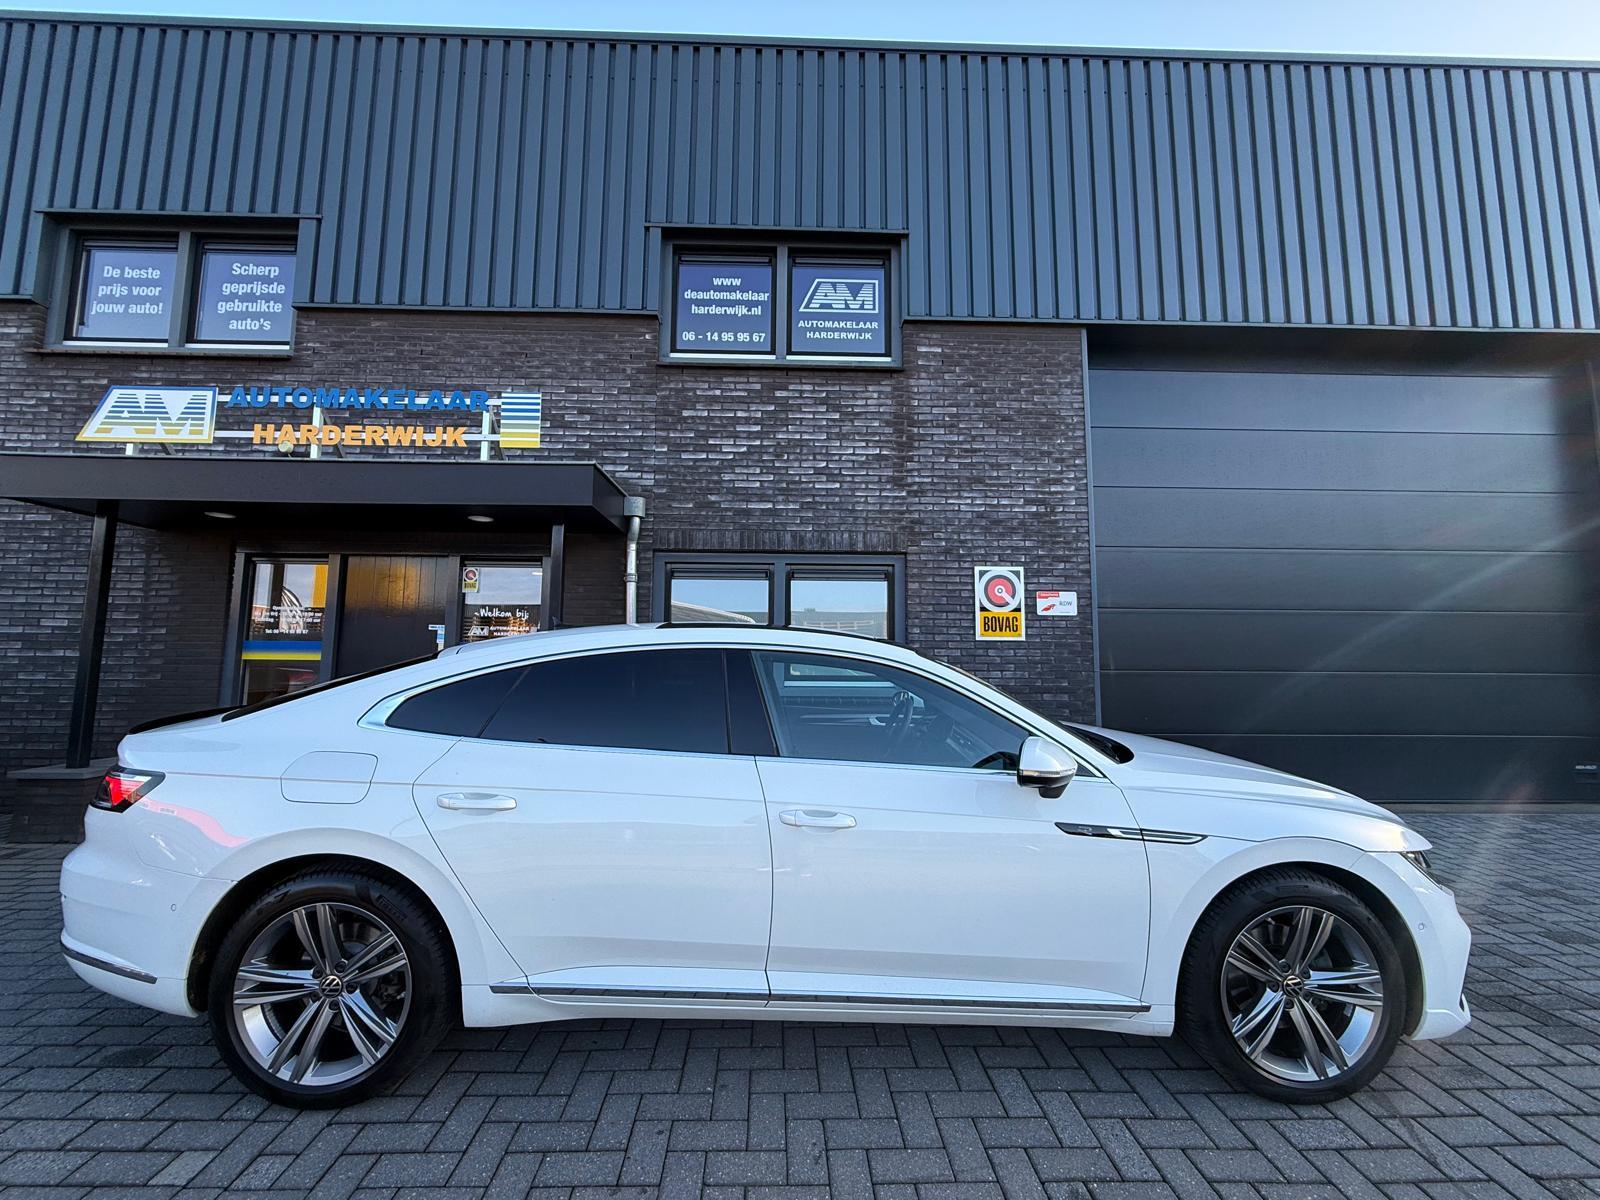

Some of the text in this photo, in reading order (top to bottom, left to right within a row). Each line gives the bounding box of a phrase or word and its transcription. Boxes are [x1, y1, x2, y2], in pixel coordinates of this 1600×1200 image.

[103, 266, 161, 279] De beste
[231, 263, 279, 278] Scherp
[222, 281, 286, 296] geprijsde
[712, 277, 741, 287] www
[98, 283, 162, 297] prijs voor
[684, 289, 769, 302] deautomakelaar
[91, 301, 163, 315] jouw auto!
[217, 299, 283, 314] gebruikte
[691, 304, 762, 317] harderwijk.nl
[229, 318, 271, 331] auto's
[798, 320, 879, 329] AUTOMAKELAAR
[682, 331, 696, 341] 06
[706, 332, 719, 341] 14
[721, 332, 734, 342] 95
[737, 332, 750, 342] 95
[752, 333, 766, 343] 67
[806, 331, 872, 340] HARDERWIJK
[225, 386, 489, 412] AUTOMAKELAAR
[252, 424, 469, 447] HARDERWIJK
[480, 606, 512, 618] Welkom
[983, 616, 1019, 633] BOVAG
